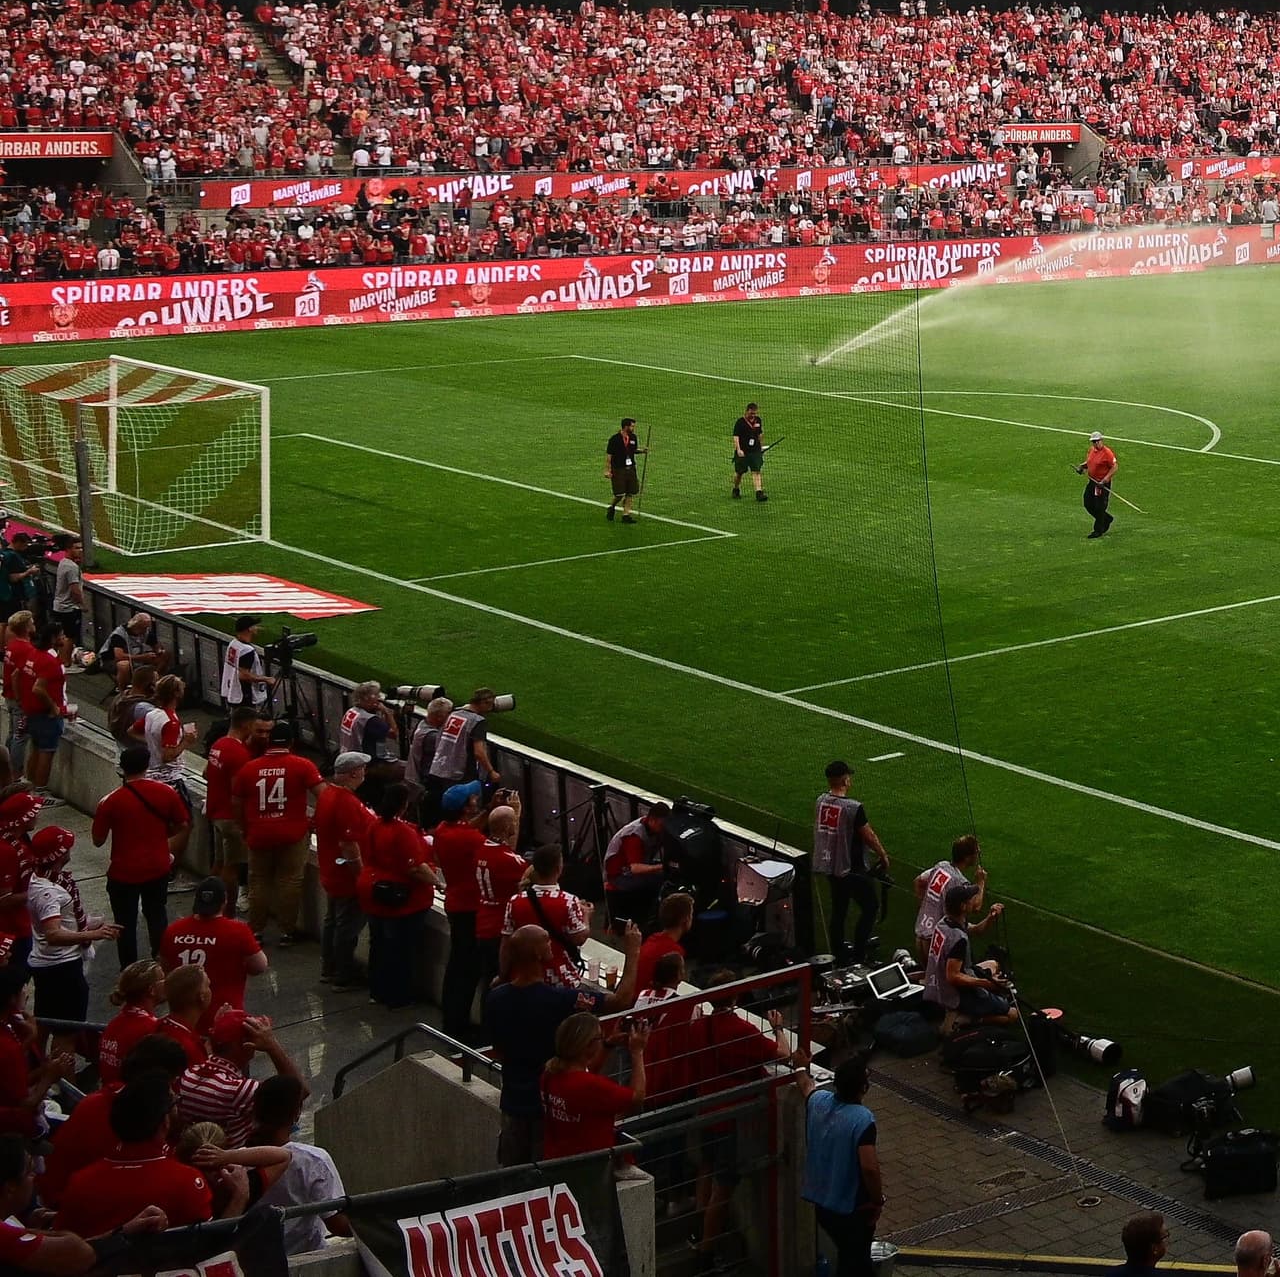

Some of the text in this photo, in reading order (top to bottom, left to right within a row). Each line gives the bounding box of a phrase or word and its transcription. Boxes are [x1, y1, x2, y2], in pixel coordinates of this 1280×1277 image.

[1040, 130, 1073, 141] ANDERS.
[45, 141, 102, 155] ANDERS.
[572, 175, 603, 193] MARVIN
[828, 170, 855, 187] MARVIN
[234, 188, 247, 202] 20
[273, 181, 310, 201] MARVIN
[296, 183, 342, 206] SCHWÄBE
[1238, 246, 1248, 261] 20
[1015, 253, 1046, 273] MARVIN
[673, 276, 686, 293] 20
[714, 269, 752, 292] MARVIN
[299, 299, 315, 316] 20
[350, 288, 397, 312] MARVIN
[259, 768, 285, 777] HECTOR
[256, 778, 288, 811] 14
[174, 934, 216, 946] KÖLN
[407, 1192, 603, 1277] MATTES
